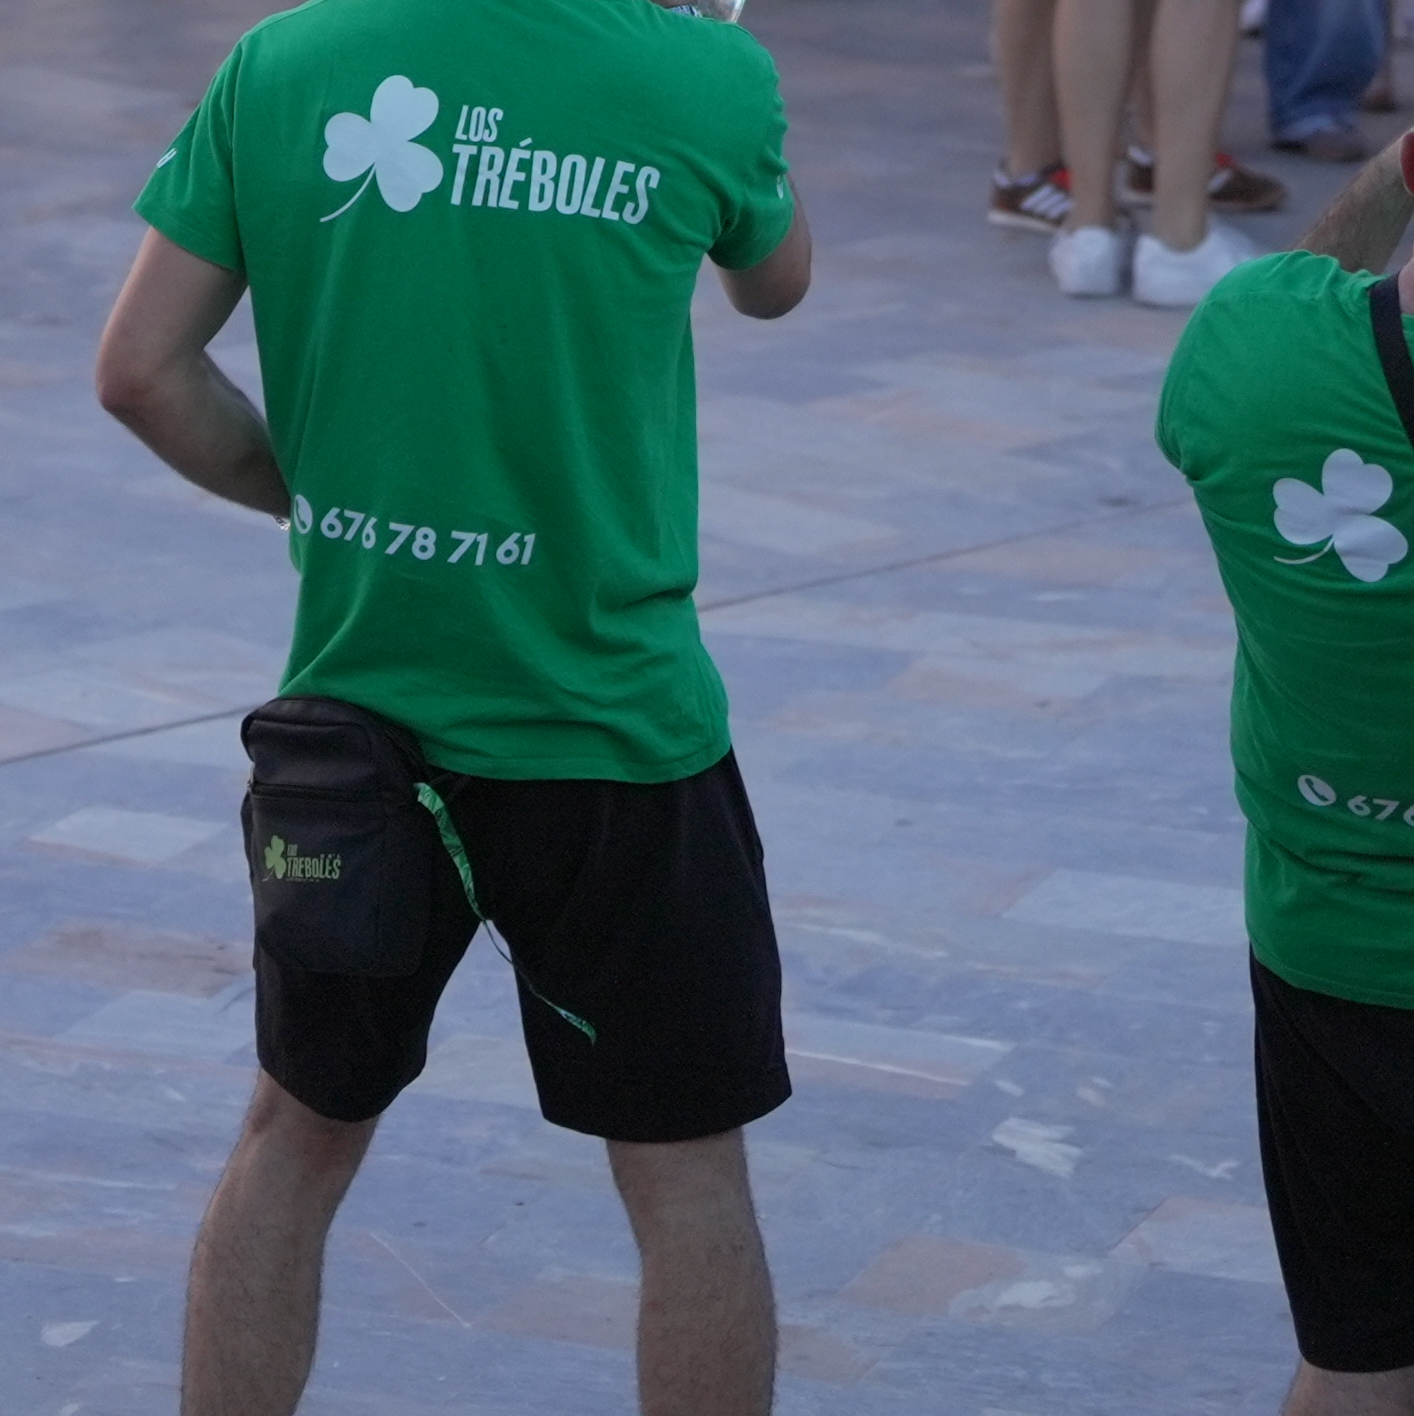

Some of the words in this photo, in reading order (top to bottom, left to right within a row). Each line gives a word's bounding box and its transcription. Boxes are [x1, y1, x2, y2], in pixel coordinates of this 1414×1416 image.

[454, 104, 504, 143] LOS
[450, 137, 661, 225] TRÉBOLES
[320, 506, 378, 550] 676
[384, 522, 437, 561] 78
[447, 530, 488, 566] 71
[496, 532, 536, 565] 61
